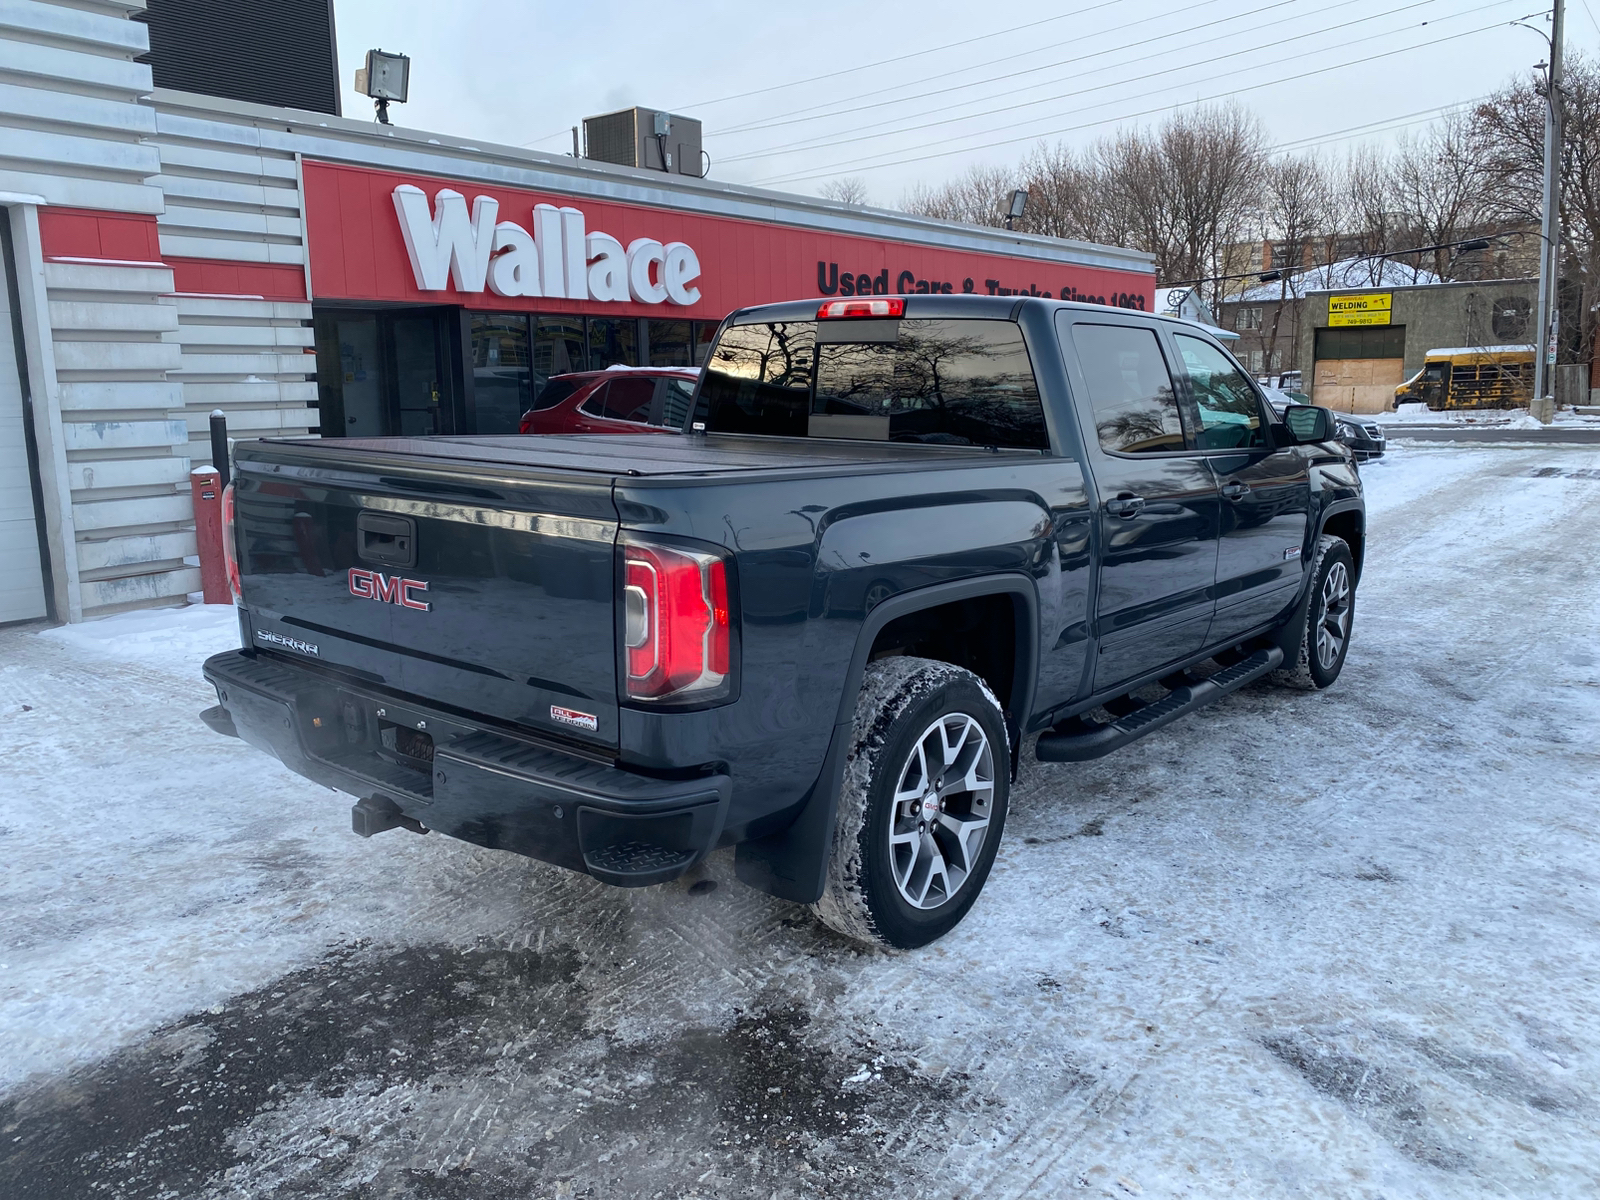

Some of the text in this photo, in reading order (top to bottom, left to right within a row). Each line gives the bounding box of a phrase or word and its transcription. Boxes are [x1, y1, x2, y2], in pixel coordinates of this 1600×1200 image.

[392, 186, 702, 306] Wallace
[817, 261, 889, 296] Used
[897, 269, 953, 295] Cars
[1111, 292, 1145, 311] 1963
[1332, 302, 1368, 310] WELDING
[348, 567, 431, 613] GMC
[257, 628, 320, 657] SIERRA
[553, 706, 573, 718] ALL
